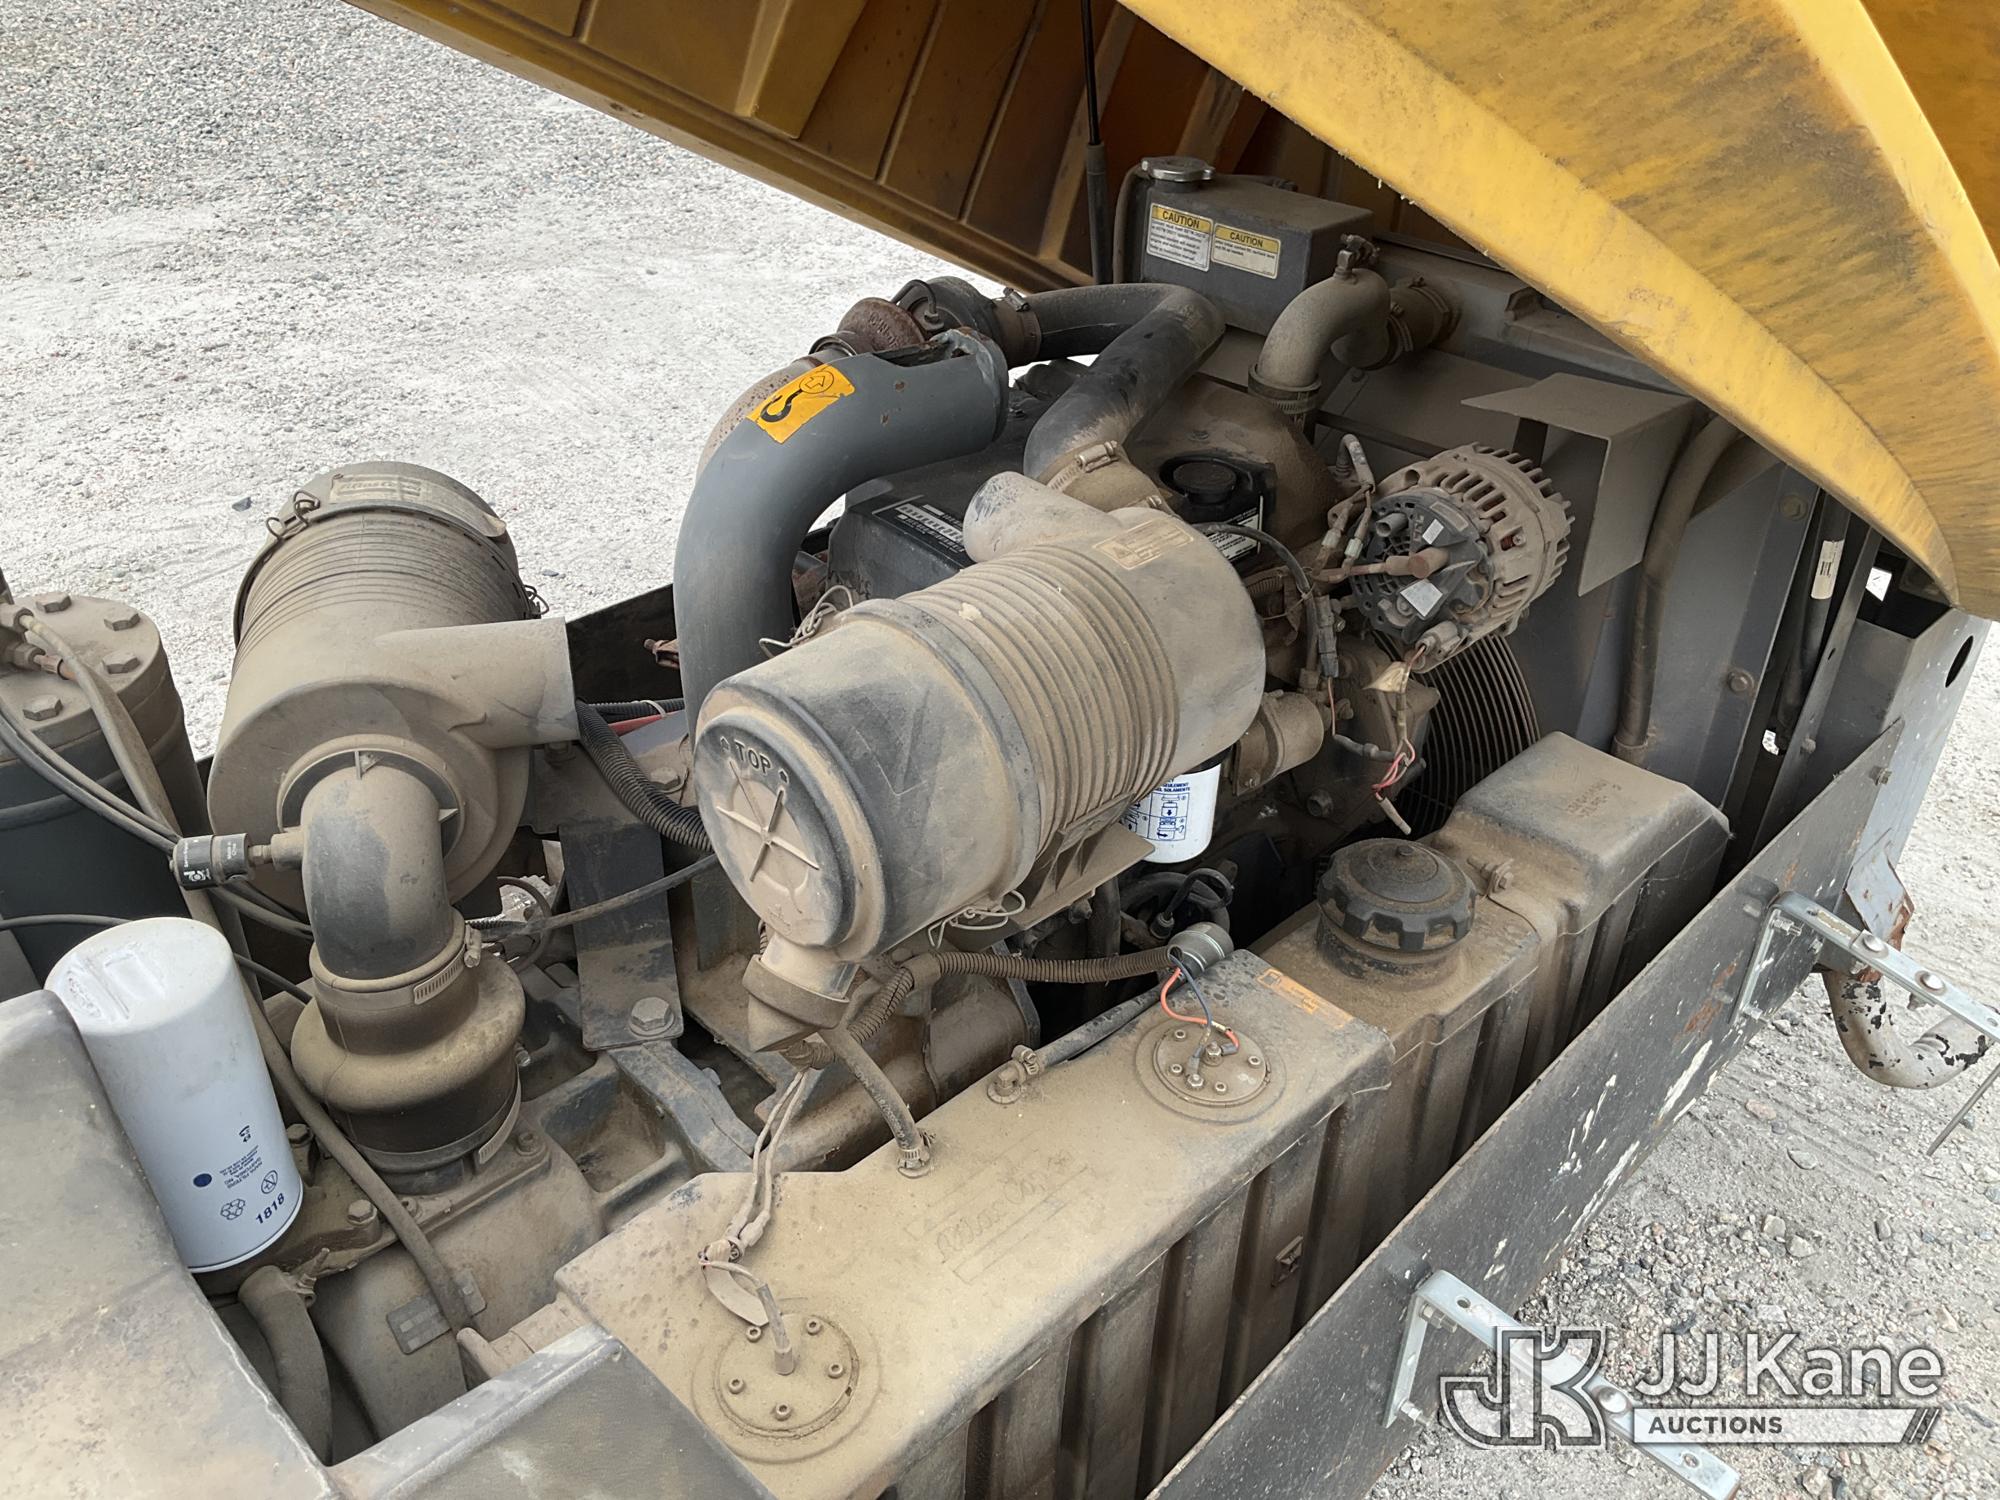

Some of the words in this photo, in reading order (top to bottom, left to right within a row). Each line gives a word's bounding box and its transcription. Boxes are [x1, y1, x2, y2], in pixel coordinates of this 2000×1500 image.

[1162, 211, 1200, 229] CAUTION
[1229, 232, 1263, 248] CAUTION
[734, 739, 772, 775] TOP
[256, 1193, 285, 1224] 1818
